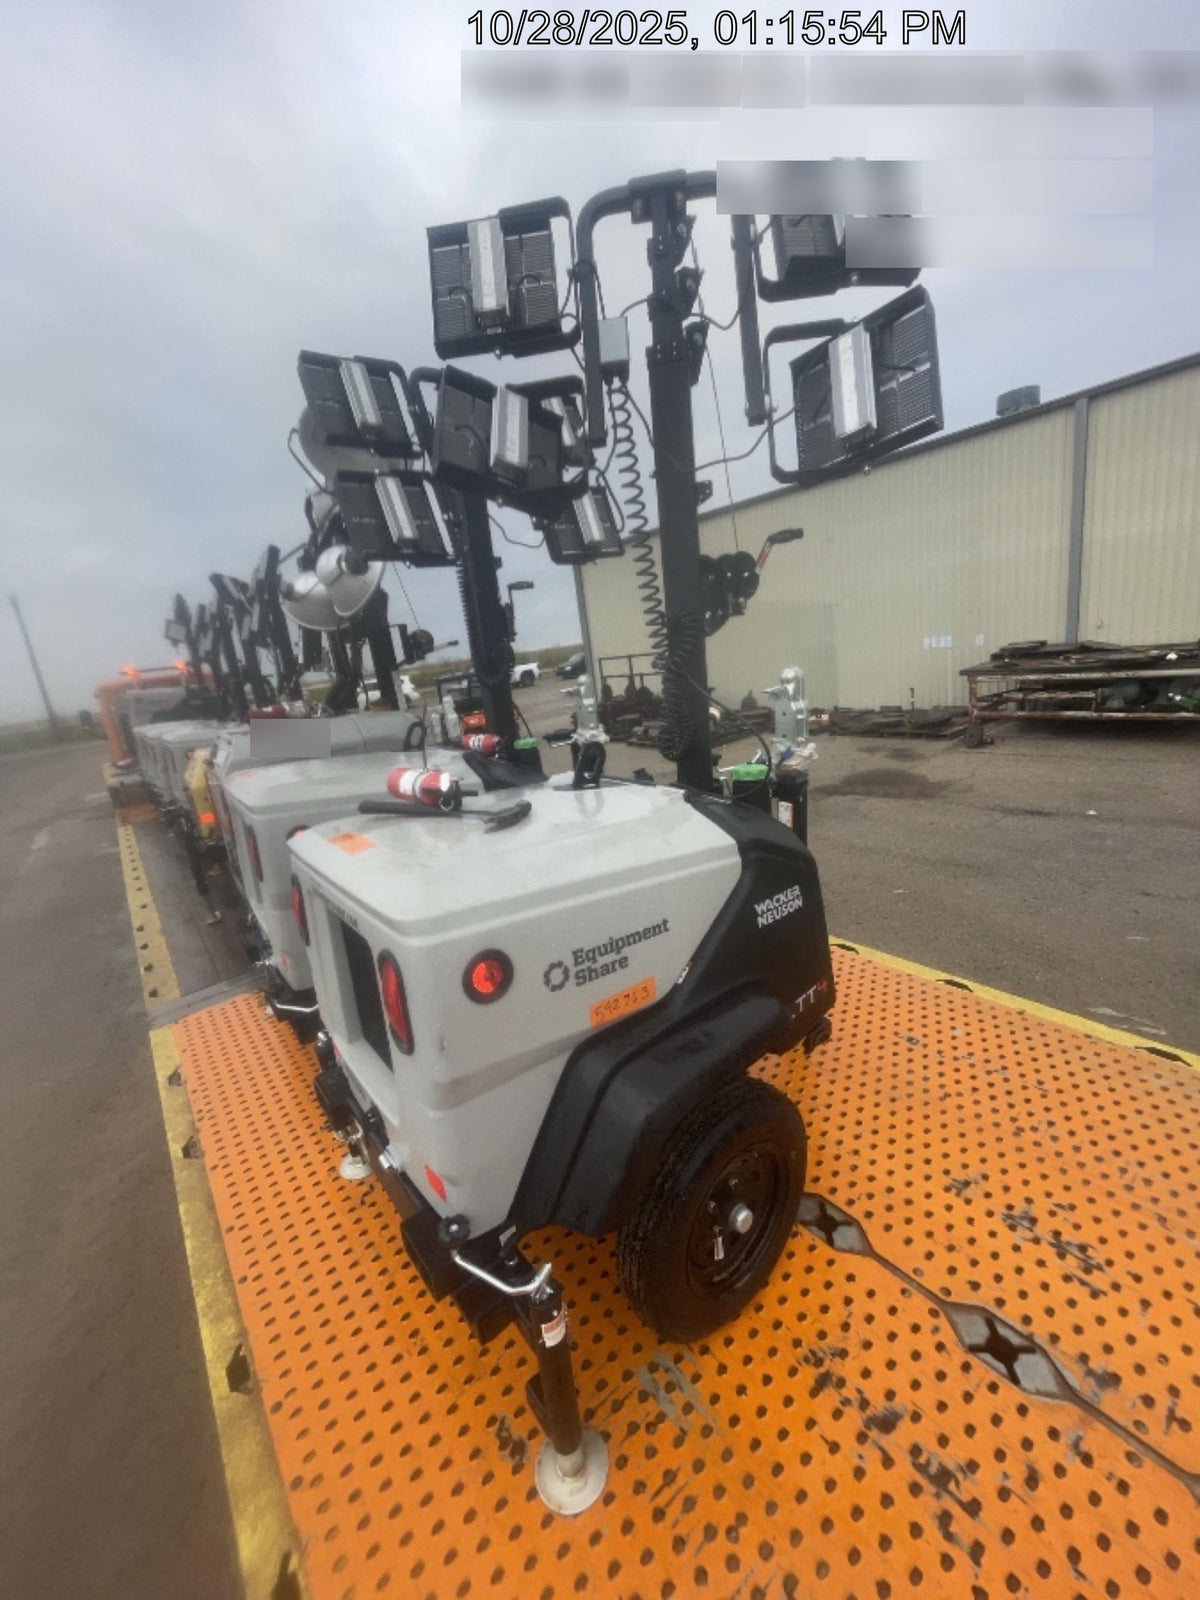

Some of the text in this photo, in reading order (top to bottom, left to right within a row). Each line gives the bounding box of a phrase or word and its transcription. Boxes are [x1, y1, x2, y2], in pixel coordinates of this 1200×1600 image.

[754, 884, 801, 915] WACKER
[757, 896, 803, 929] NEUSON
[571, 918, 670, 968] Equipment
[574, 955, 629, 987] Share
